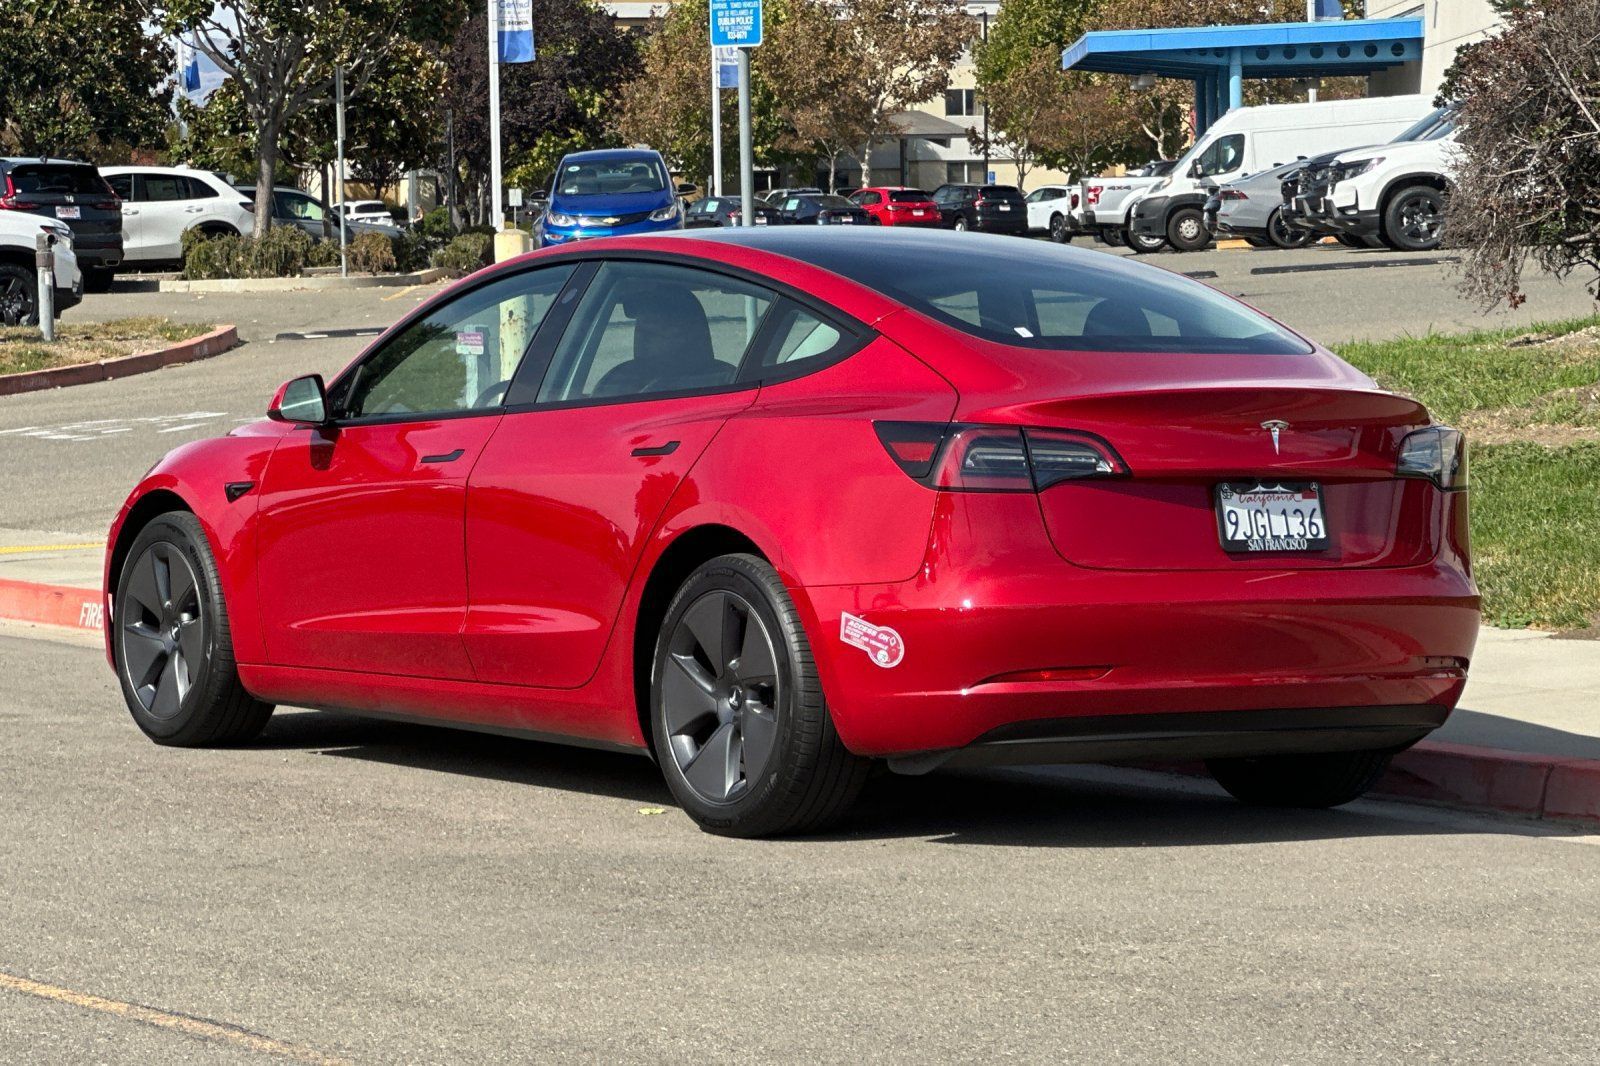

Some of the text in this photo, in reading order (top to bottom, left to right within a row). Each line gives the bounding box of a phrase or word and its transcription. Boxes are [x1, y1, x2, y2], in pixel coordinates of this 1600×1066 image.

[718, 16, 754, 26] DUBLIN POLICE
[1222, 492, 1234, 500] SEP
[1238, 492, 1302, 507] California
[1226, 507, 1321, 540] 9JGL136
[1248, 538, 1308, 551] SAN FRANCISCO
[79, 602, 103, 629] FIRE
[848, 620, 878, 637] ACCESS
[877, 633, 890, 642] OK
